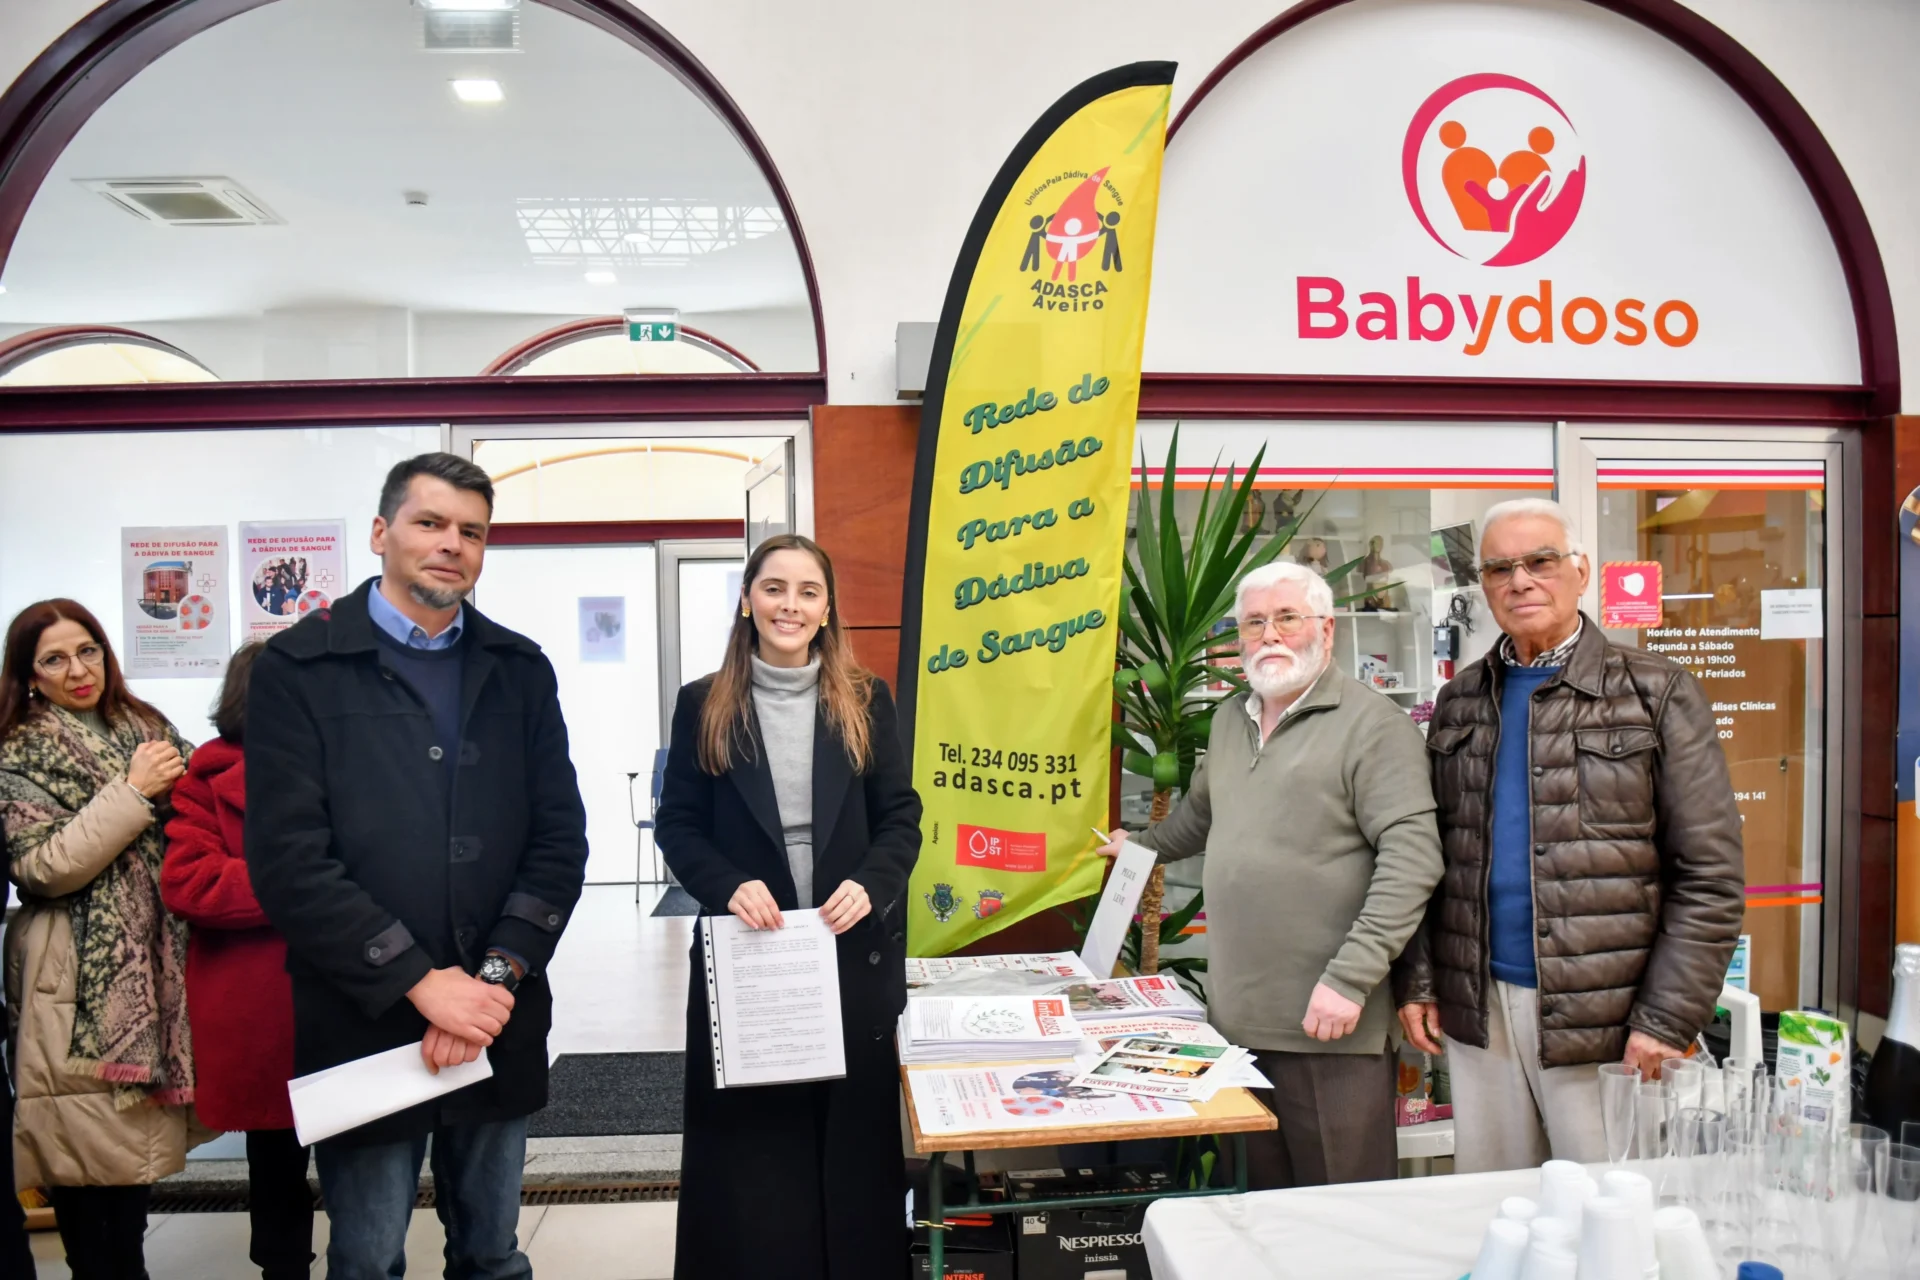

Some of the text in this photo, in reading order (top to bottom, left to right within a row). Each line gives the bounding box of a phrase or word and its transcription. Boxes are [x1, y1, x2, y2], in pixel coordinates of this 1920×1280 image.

[1024, 170, 1124, 207] Unidos Pela Dádiva de Sangue
[1030, 278, 1108, 299] ADASCA
[1032, 294, 1104, 312] Aveiro
[1296, 275, 1699, 356] Babydoso
[963, 373, 1110, 435] Rede de
[959, 436, 1103, 494] Difusão
[957, 497, 1095, 550] Para a
[954, 557, 1090, 610] Dádiva
[1646, 627, 1760, 637] Horário de Atendimento
[927, 609, 1106, 674] de Sangue
[1646, 642, 1688, 652] Segunda
[1699, 641, 1735, 650] Sábado
[1694, 655, 1705, 665] às
[1707, 655, 1736, 664] 19h00
[1705, 668, 1746, 678] Feriados
[1711, 701, 1776, 711] álises Clínicas
[1715, 716, 1734, 725] ado
[939, 742, 1077, 774] Tel. 234 095 331
[933, 768, 1082, 805] adasca.pt
[1752, 792, 1766, 801] 141
[990, 836, 1000, 846] IP
[989, 845, 1002, 856] ST
[1024, 1217, 1035, 1225] 40
[1056, 1232, 1144, 1251] NESPRESSO
[1084, 1252, 1119, 1263] inissia
